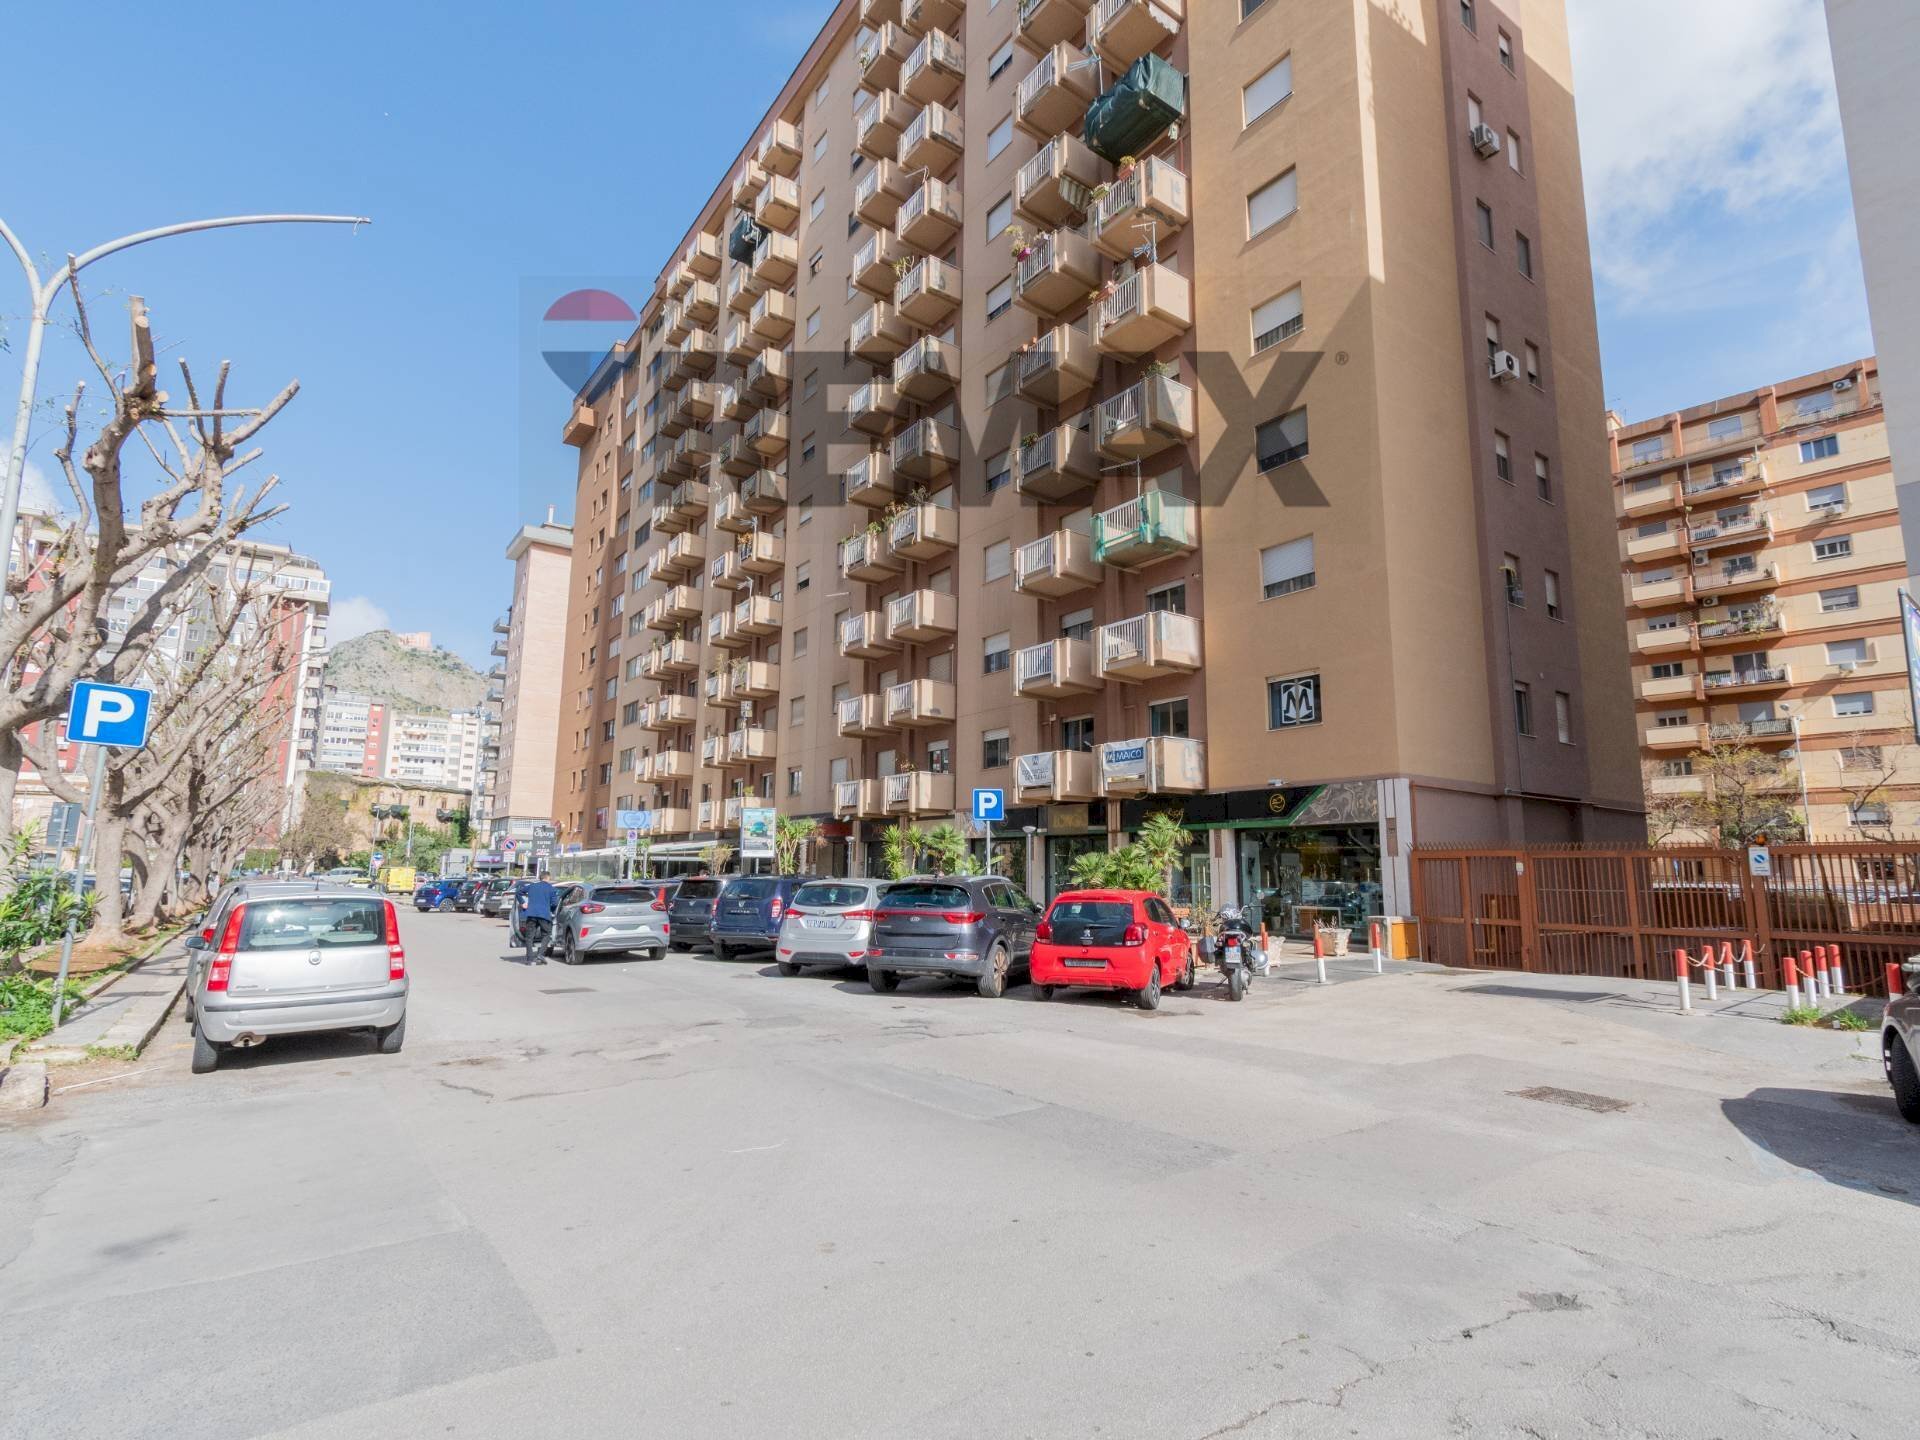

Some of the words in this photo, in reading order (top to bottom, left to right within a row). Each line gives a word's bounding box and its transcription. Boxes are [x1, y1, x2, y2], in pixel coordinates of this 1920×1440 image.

[83, 689, 135, 737] P
[1116, 749, 1142, 761] MAICO
[979, 792, 998, 817] P
